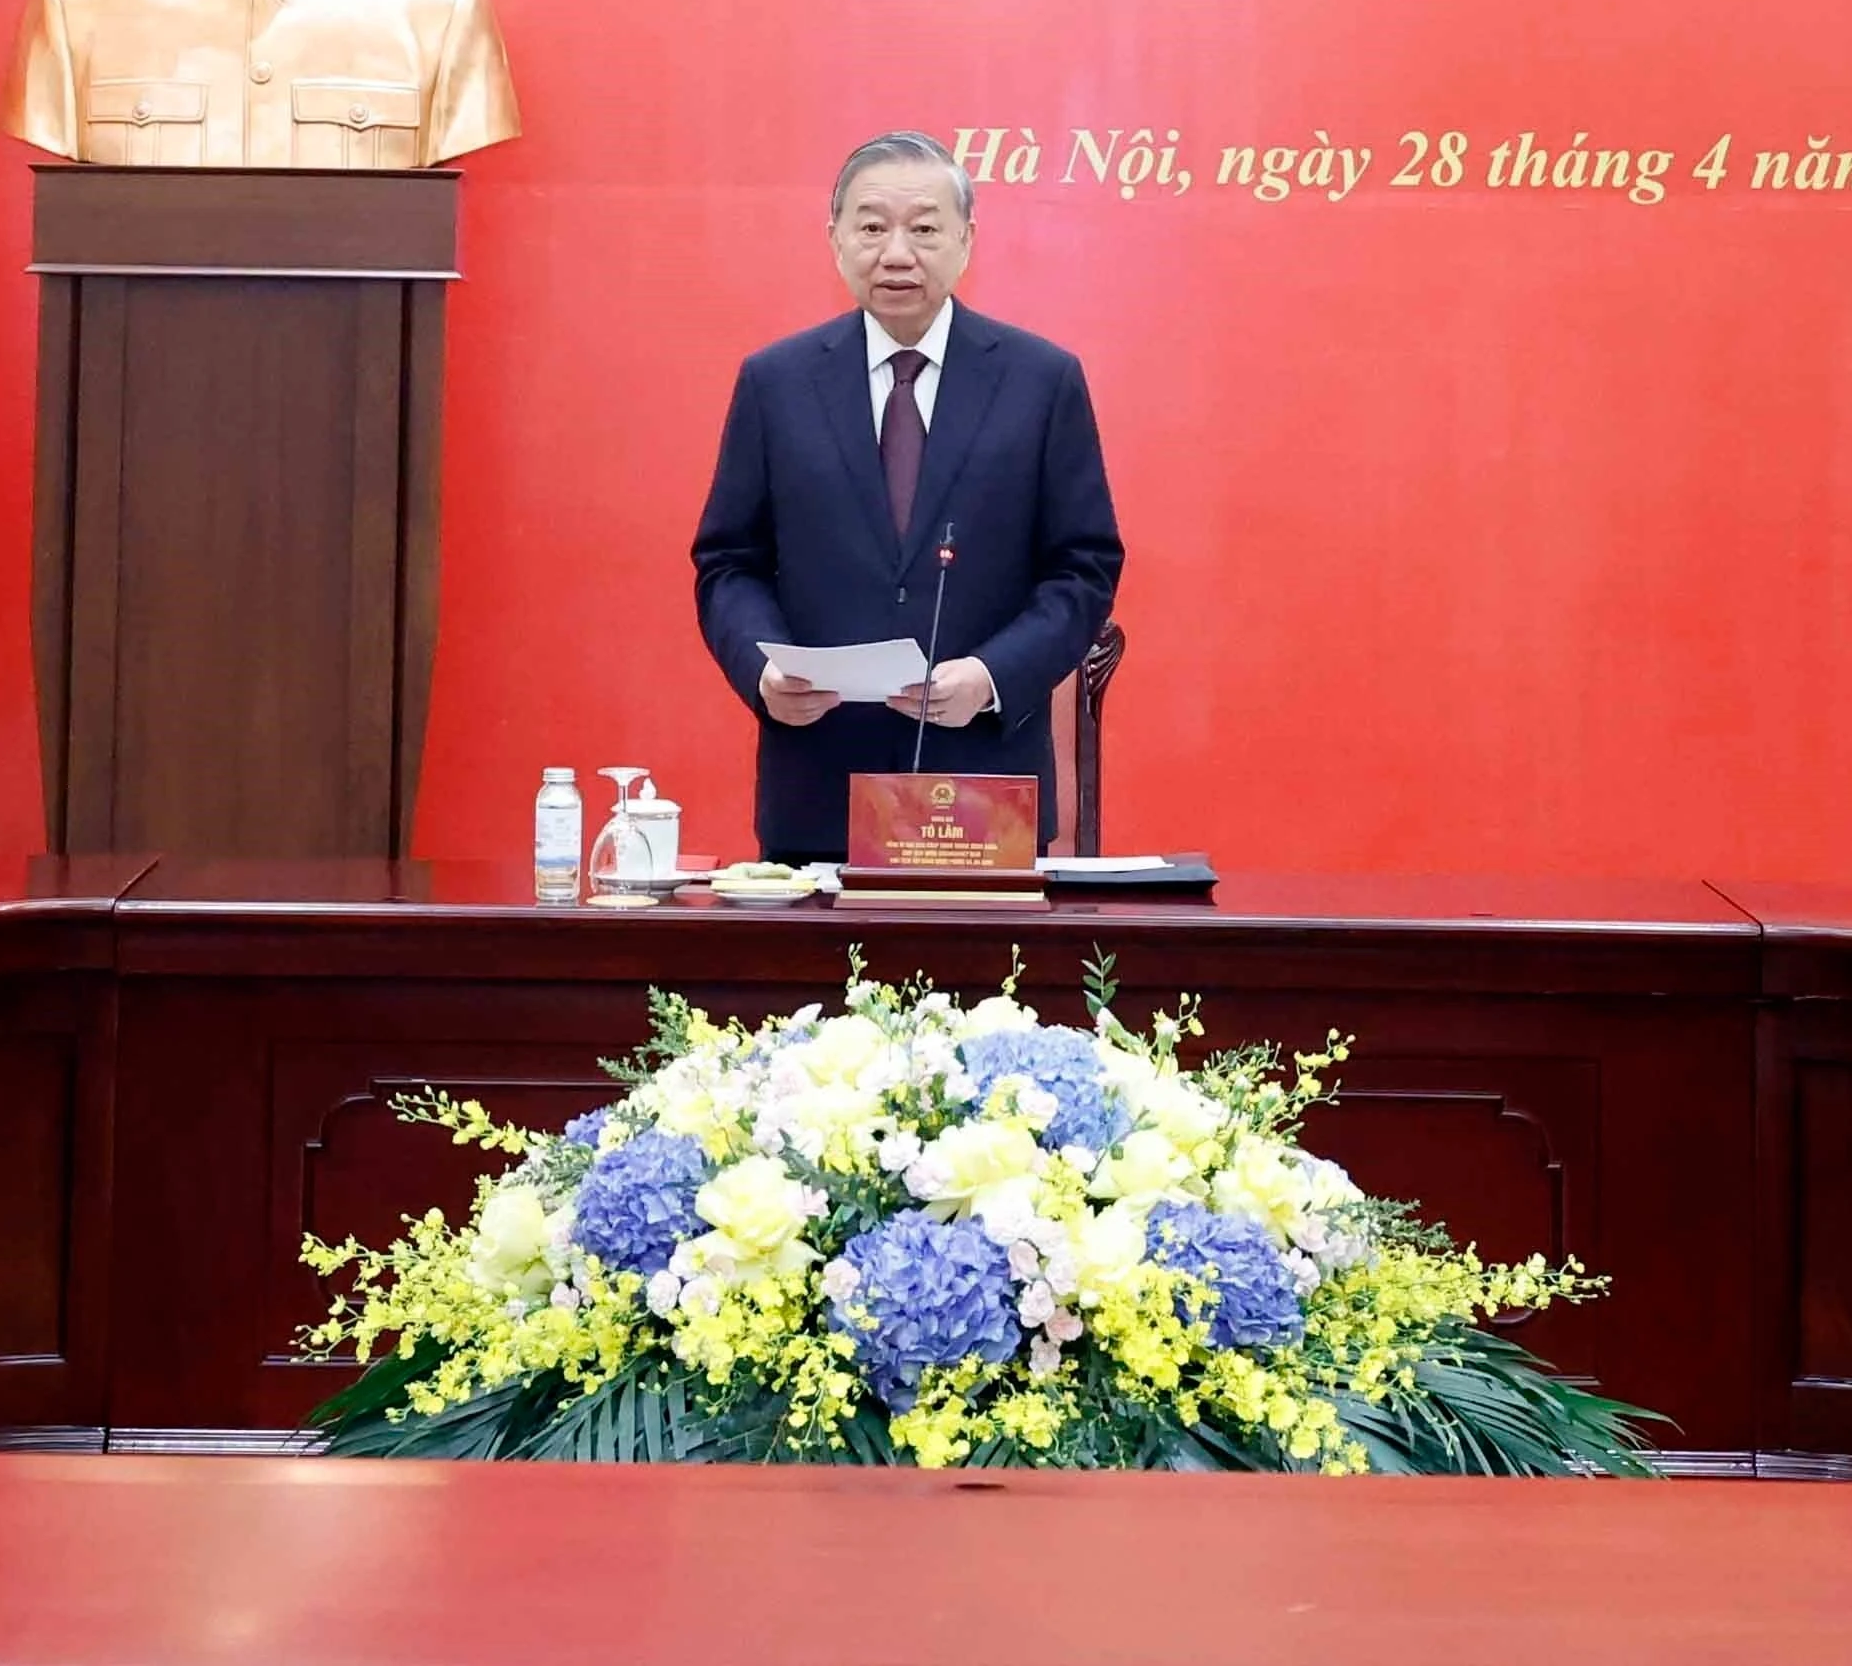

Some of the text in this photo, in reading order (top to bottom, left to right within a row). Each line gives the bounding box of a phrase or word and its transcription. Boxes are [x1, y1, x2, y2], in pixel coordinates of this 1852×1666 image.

[952, 127, 1041, 183] Hà
[1059, 129, 1192, 200] Nội,
[1215, 131, 1371, 202] ngày
[1390, 131, 1467, 187] 28
[1487, 132, 1674, 205] tháng
[1692, 135, 1731, 190] 4
